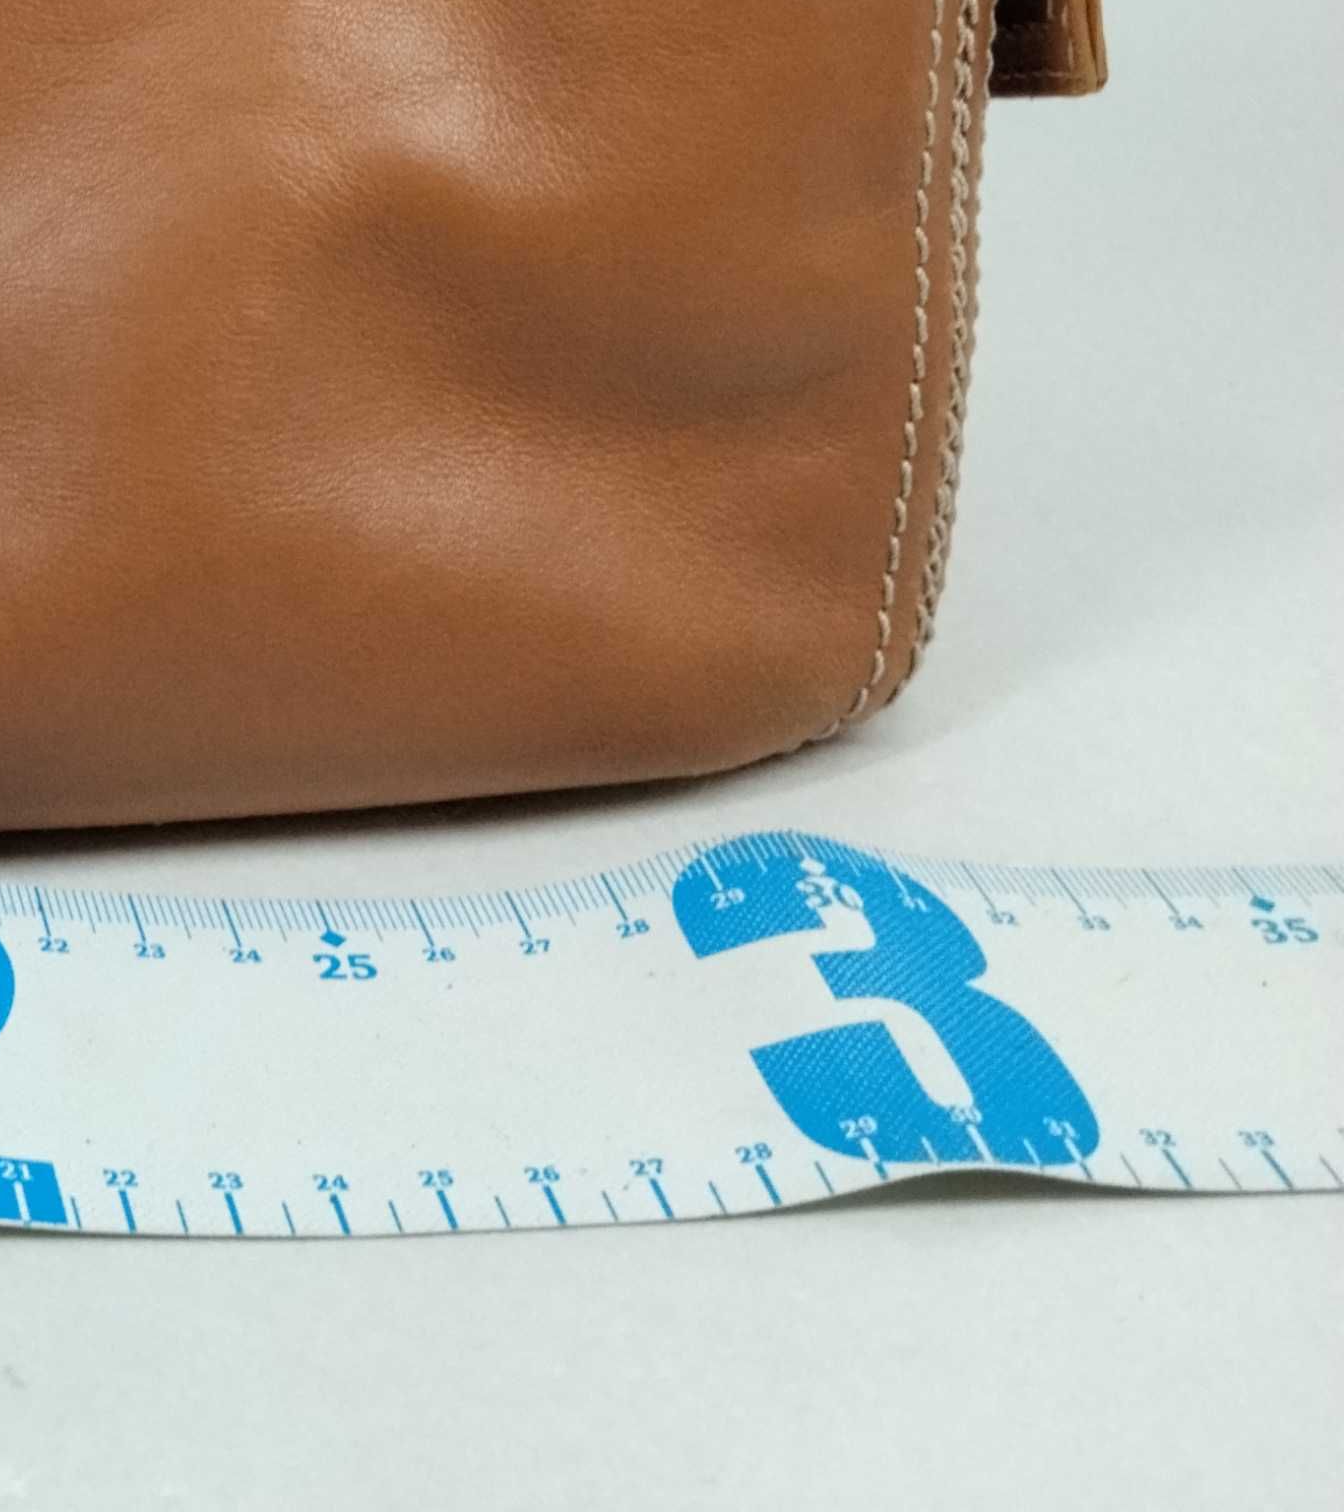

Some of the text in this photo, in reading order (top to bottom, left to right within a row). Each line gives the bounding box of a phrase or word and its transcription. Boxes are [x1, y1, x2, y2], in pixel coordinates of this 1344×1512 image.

[38, 935, 70, 954] 22
[133, 942, 166, 960] 23
[228, 948, 262, 964] 24
[312, 953, 379, 980] 25
[422, 946, 456, 963] 26
[519, 937, 551, 956] 27
[616, 918, 651, 939] 28
[711, 889, 747, 909] 29
[986, 908, 1020, 927] 32
[1077, 913, 1112, 932] 33
[1168, 914, 1205, 932] 34
[1251, 917, 1320, 945] 35
[672, 829, 1100, 1165] 3
[0, 1161, 33, 1182] 21
[103, 1169, 139, 1187] 22
[208, 1172, 243, 1189] 23
[312, 1174, 349, 1192] 24
[418, 1170, 454, 1187] 25
[524, 1164, 560, 1185] 26
[629, 1158, 664, 1177] 27
[735, 1143, 773, 1163] 28
[839, 1116, 879, 1139] 29
[1139, 1128, 1176, 1148] 32
[1238, 1130, 1274, 1148] 33
